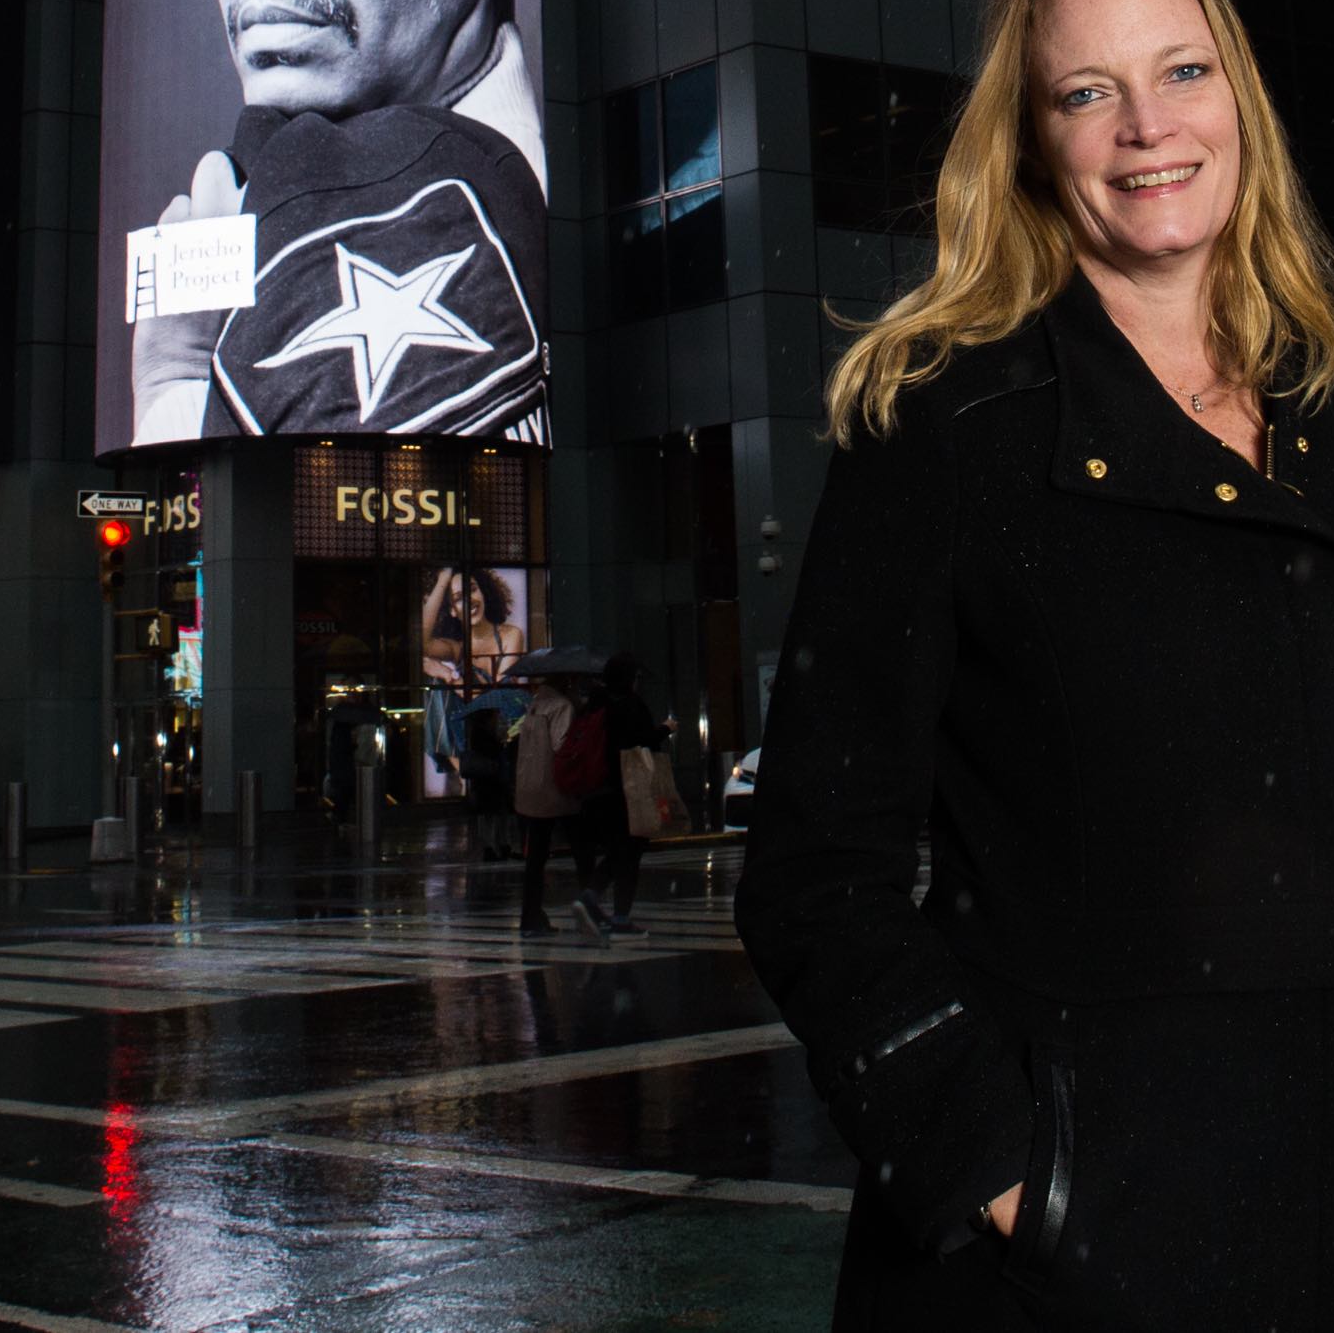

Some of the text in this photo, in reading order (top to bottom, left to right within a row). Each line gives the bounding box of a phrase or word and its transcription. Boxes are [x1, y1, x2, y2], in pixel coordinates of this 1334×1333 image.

[169, 239, 241, 267] Jericho
[172, 268, 241, 292] Project
[91, 499, 138, 510] ONE WAY
[336, 485, 482, 527] FOSSIL
